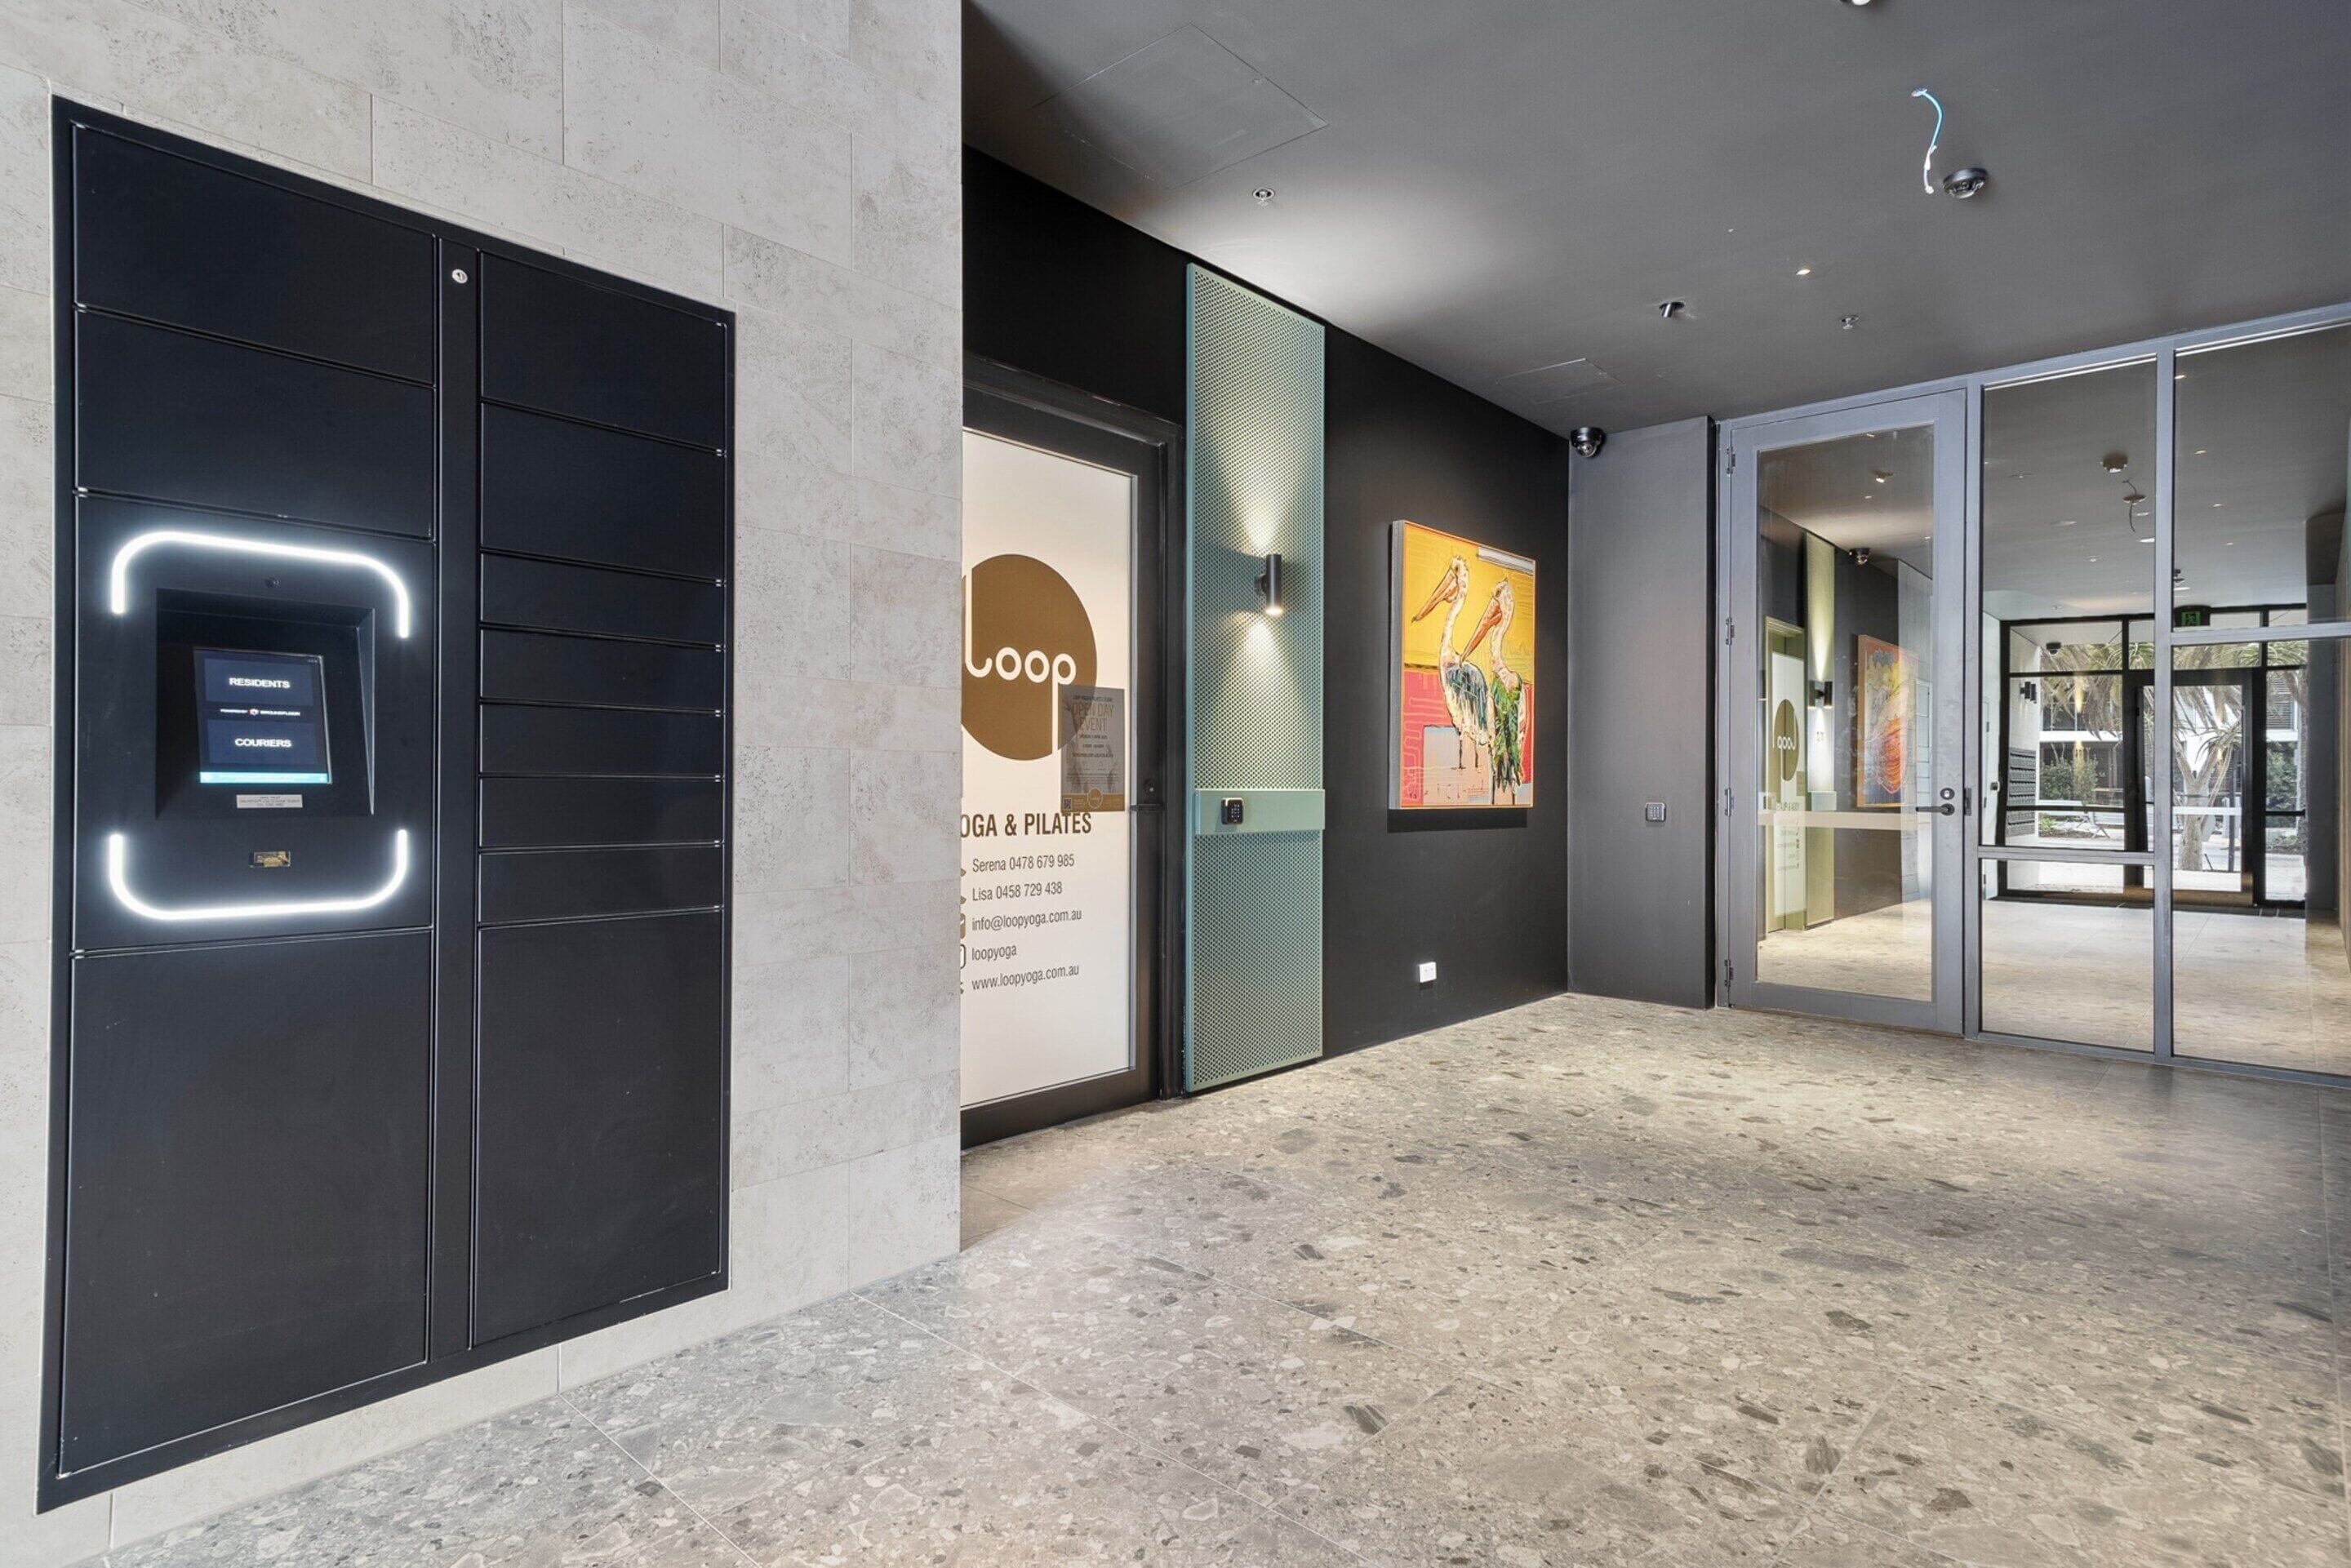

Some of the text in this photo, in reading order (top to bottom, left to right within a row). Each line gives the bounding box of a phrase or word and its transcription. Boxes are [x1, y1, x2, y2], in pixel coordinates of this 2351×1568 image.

[229, 677, 291, 689] RESIDENTS
[234, 738, 293, 748] COURIERS
[1004, 813, 1017, 837] &
[1024, 811, 1091, 836] PILATES
[972, 854, 1075, 873] Serena 0478 679 985
[972, 881, 1063, 901] Lisa 0458 729 438
[971, 910, 1082, 931] info@loopyoga.com.au
[971, 945, 1017, 962] loopyoga
[971, 965, 1079, 990] www.loopyoga.com.au
